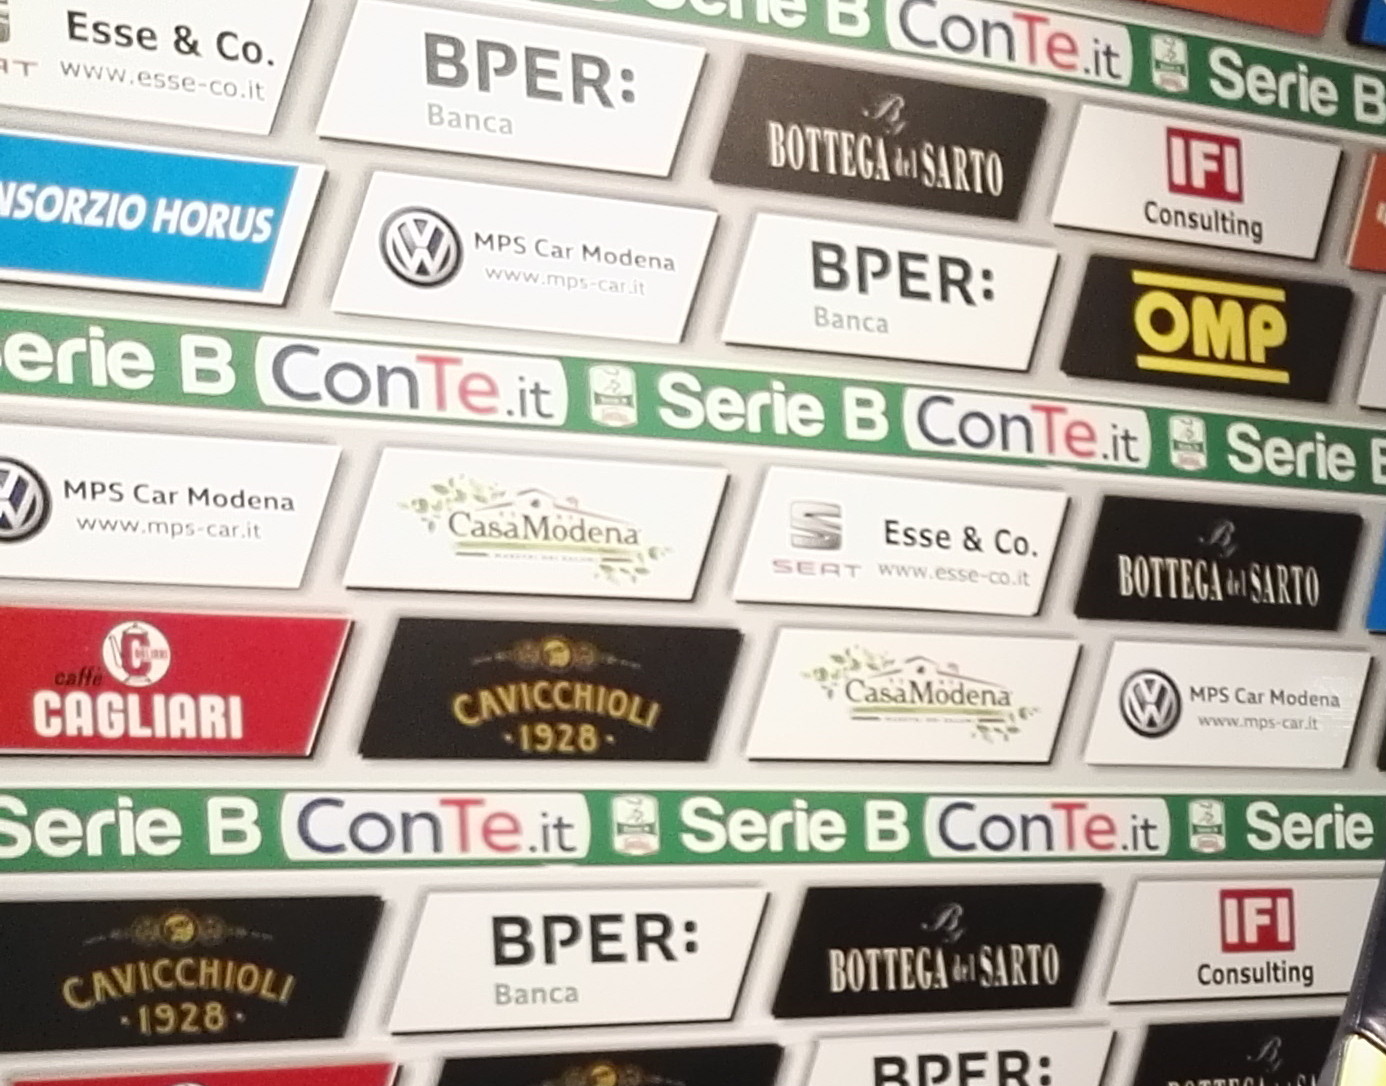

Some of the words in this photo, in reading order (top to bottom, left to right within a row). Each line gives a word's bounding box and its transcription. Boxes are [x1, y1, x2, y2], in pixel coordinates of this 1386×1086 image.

[66, 10, 159, 52] Esse
[174, 26, 202, 58] &
[216, 31, 275, 66] Co.
[901, 0, 1122, 80] ConTe.it
[60, 59, 267, 102] www.esse-co.it
[423, 31, 638, 110] BPER:
[427, 103, 514, 136] Banca
[768, 120, 891, 182] BOTTEGA
[895, 147, 920, 178] del
[921, 143, 1005, 196] SARTO
[1168, 133, 1241, 195] IFI
[0, 180, 148, 231] NSORZIO
[152, 197, 274, 244] HORUS
[1144, 201, 1263, 243] Consulting
[473, 231, 527, 255] MPS
[534, 238, 574, 261] Car
[581, 245, 677, 272] Modena
[811, 240, 994, 306] BPER:
[485, 266, 646, 296] www.mps-car.it
[813, 305, 889, 335] Banca
[1135, 289, 1287, 364] OMP
[0, 325, 156, 390] erie
[180, 334, 236, 394] B
[271, 343, 554, 421] ConTe.it
[64, 479, 124, 503] MPS
[133, 484, 177, 506] Car
[188, 488, 296, 512] Modena
[77, 516, 262, 540] www.mps-car.it
[885, 519, 951, 550] Esse
[964, 527, 983, 552] &
[995, 530, 1038, 557] Co.
[772, 559, 861, 576] SEAT
[878, 562, 1031, 587] www.esse-co.it
[1119, 554, 1222, 601] BOTTEGA
[1226, 573, 1247, 597] del
[1249, 564, 1320, 608] SARTO
[33, 690, 243, 740] CAGLIARI
[452, 680, 660, 731] CAVICCHIOLI
[1189, 686, 1229, 705] MPS
[1234, 688, 1265, 706] Car
[1270, 689, 1341, 708] Modena
[1198, 714, 1319, 733] www.mps-car.it
[207, 796, 262, 856] B
[299, 798, 577, 854] ConTe.it
[492, 912, 699, 967] BPER:
[1224, 897, 1293, 944] IFI
[62, 957, 297, 1010] CAVICCHIOLI
[495, 981, 579, 1006] Banca
[829, 947, 949, 994] BOTTEGA
[953, 948, 976, 983] del
[980, 943, 1059, 988] SARTO
[1198, 960, 1314, 988] Consulting
